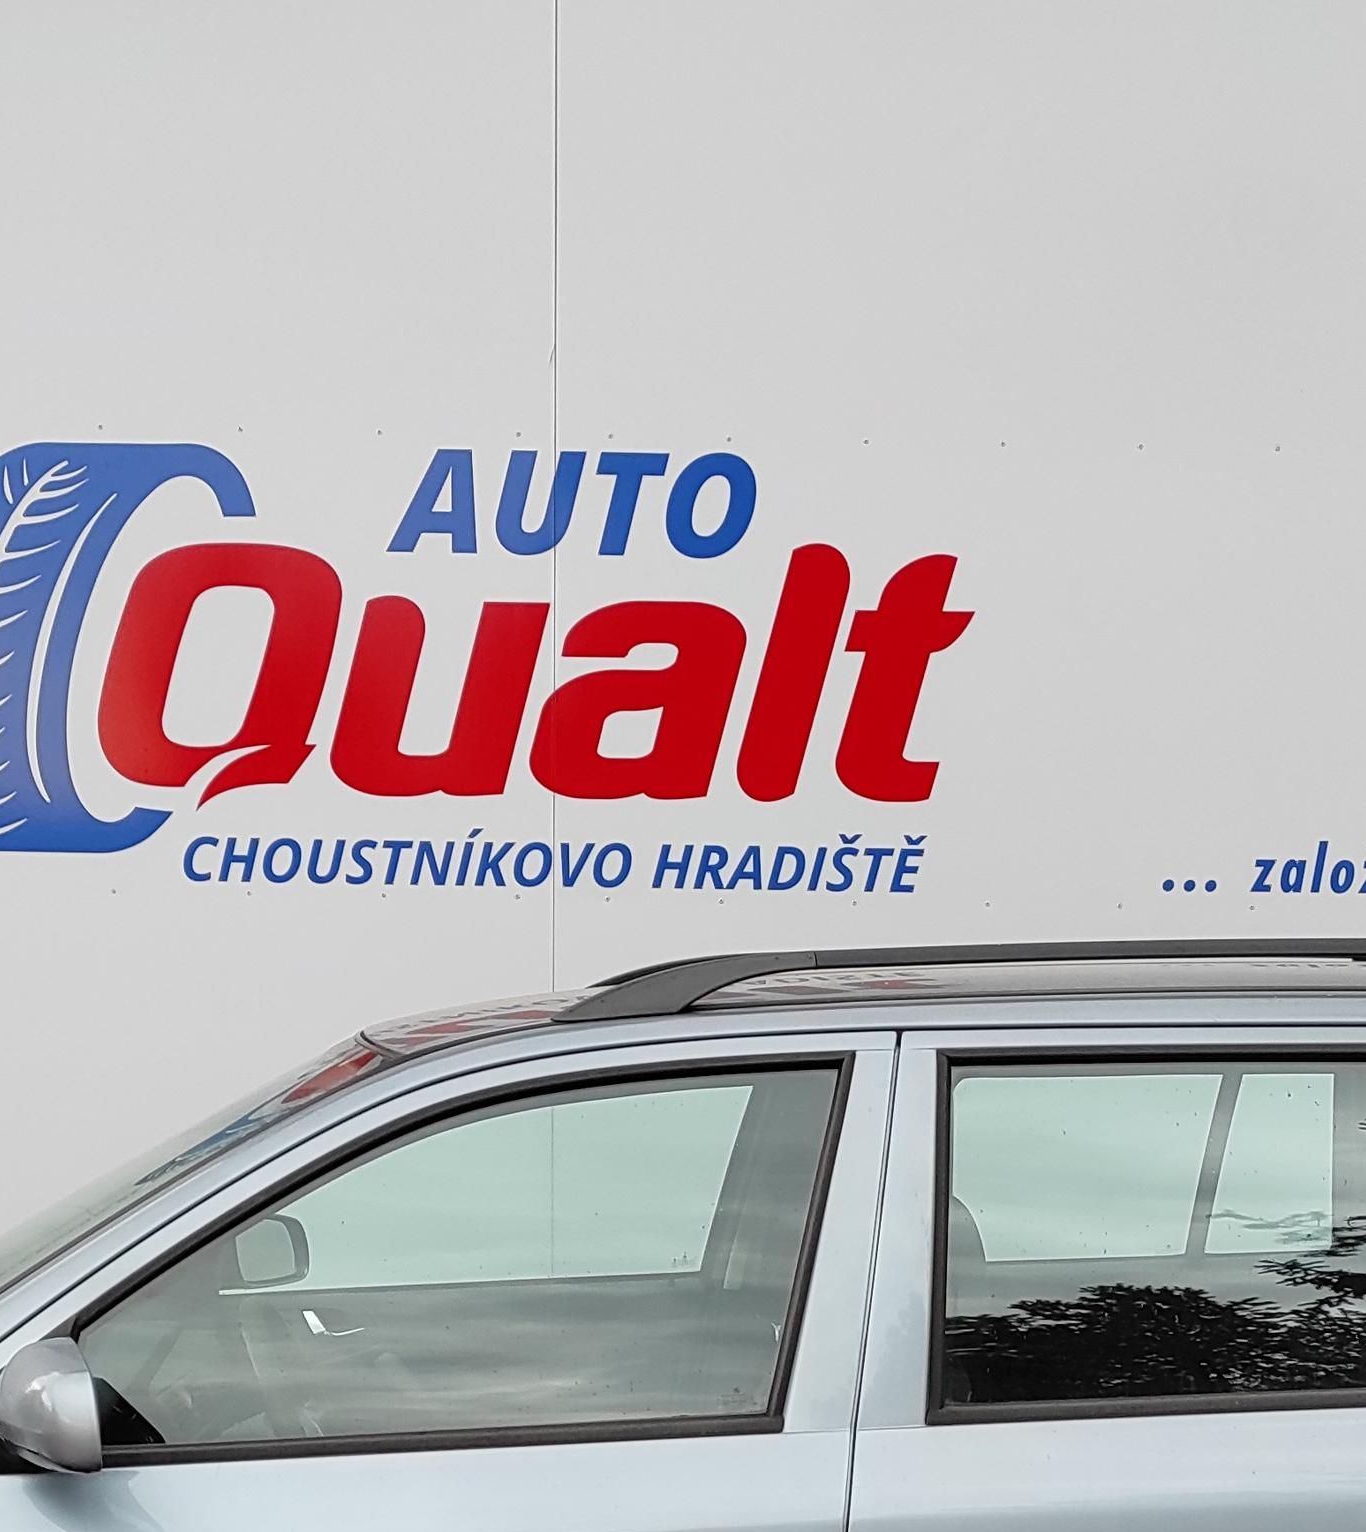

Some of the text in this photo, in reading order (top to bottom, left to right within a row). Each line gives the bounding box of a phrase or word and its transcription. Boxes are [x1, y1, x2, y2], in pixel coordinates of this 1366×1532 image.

[386, 448, 757, 560] AUTO
[97, 542, 975, 810] Qualt
[183, 828, 925, 894] CHOUSTNÍKOVO HRADIŠTĚ
